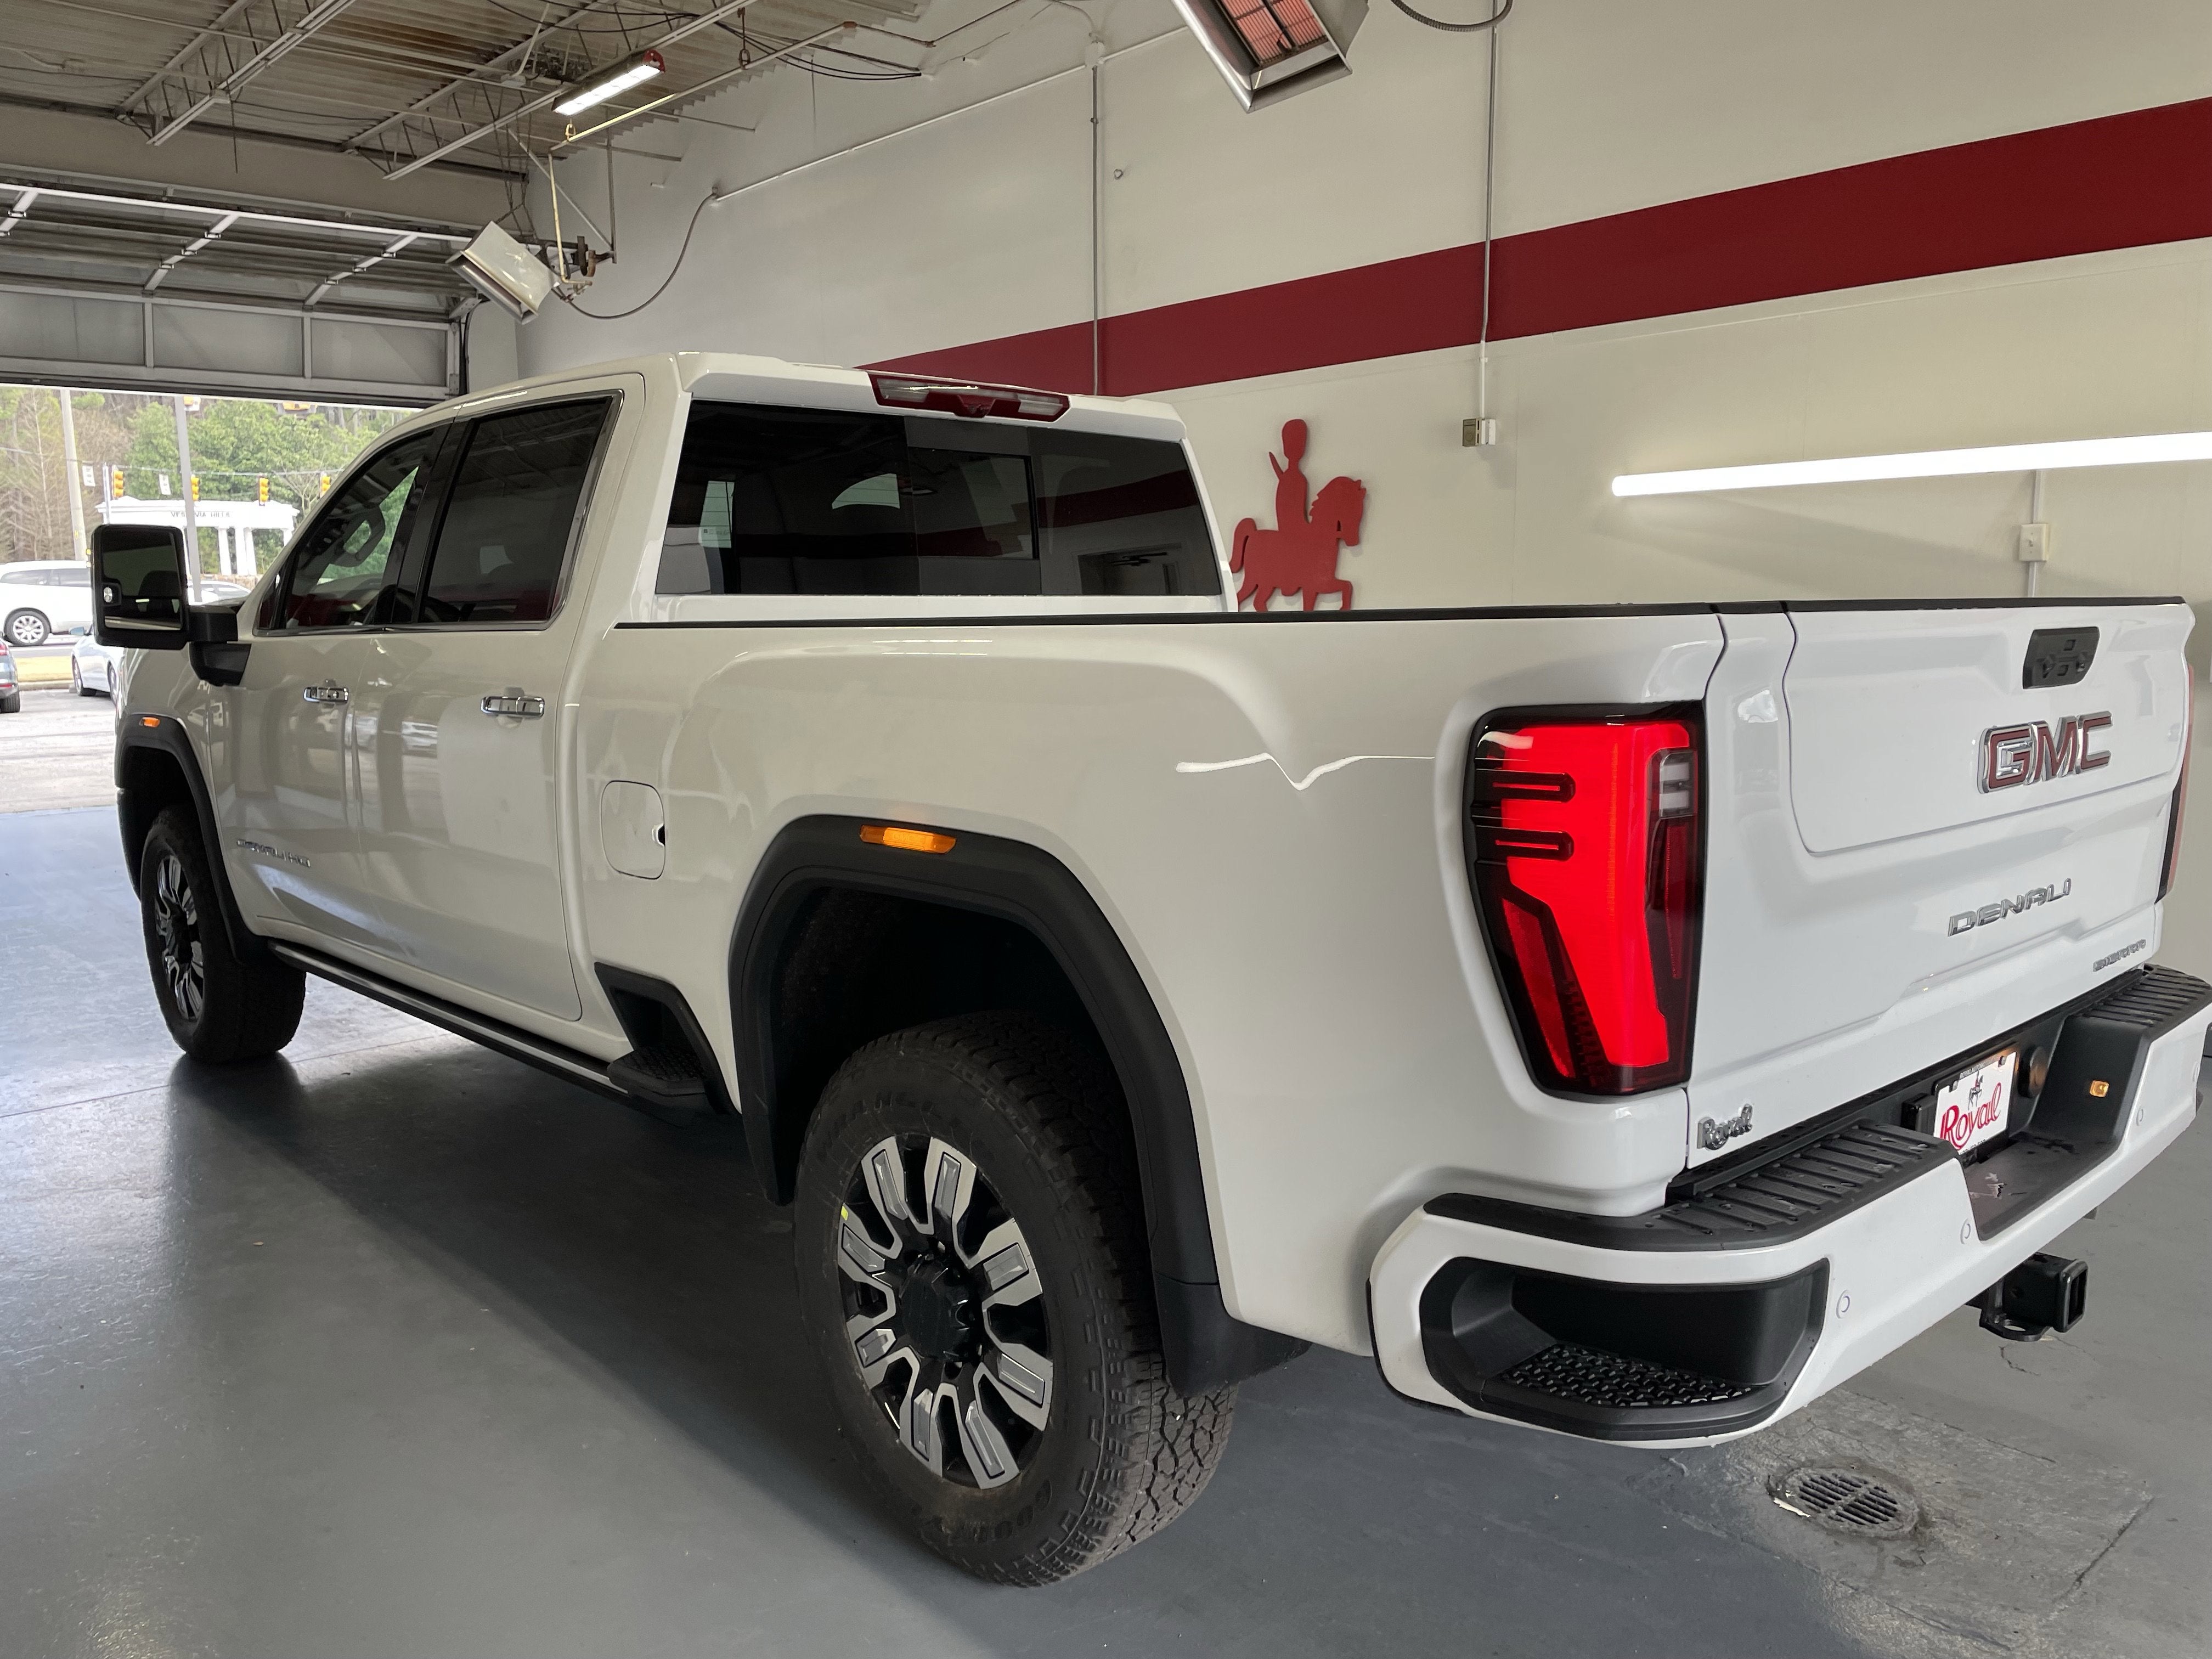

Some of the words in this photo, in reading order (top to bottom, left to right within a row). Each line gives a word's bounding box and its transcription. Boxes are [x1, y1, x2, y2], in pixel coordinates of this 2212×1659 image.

[1977, 710, 2112, 794] GMC
[1948, 878, 2072, 936] DENALI
[2093, 939, 2146, 972] SIERRA
[1697, 1103, 1753, 1150] Royal
[1940, 1082, 2001, 1150] Royal
